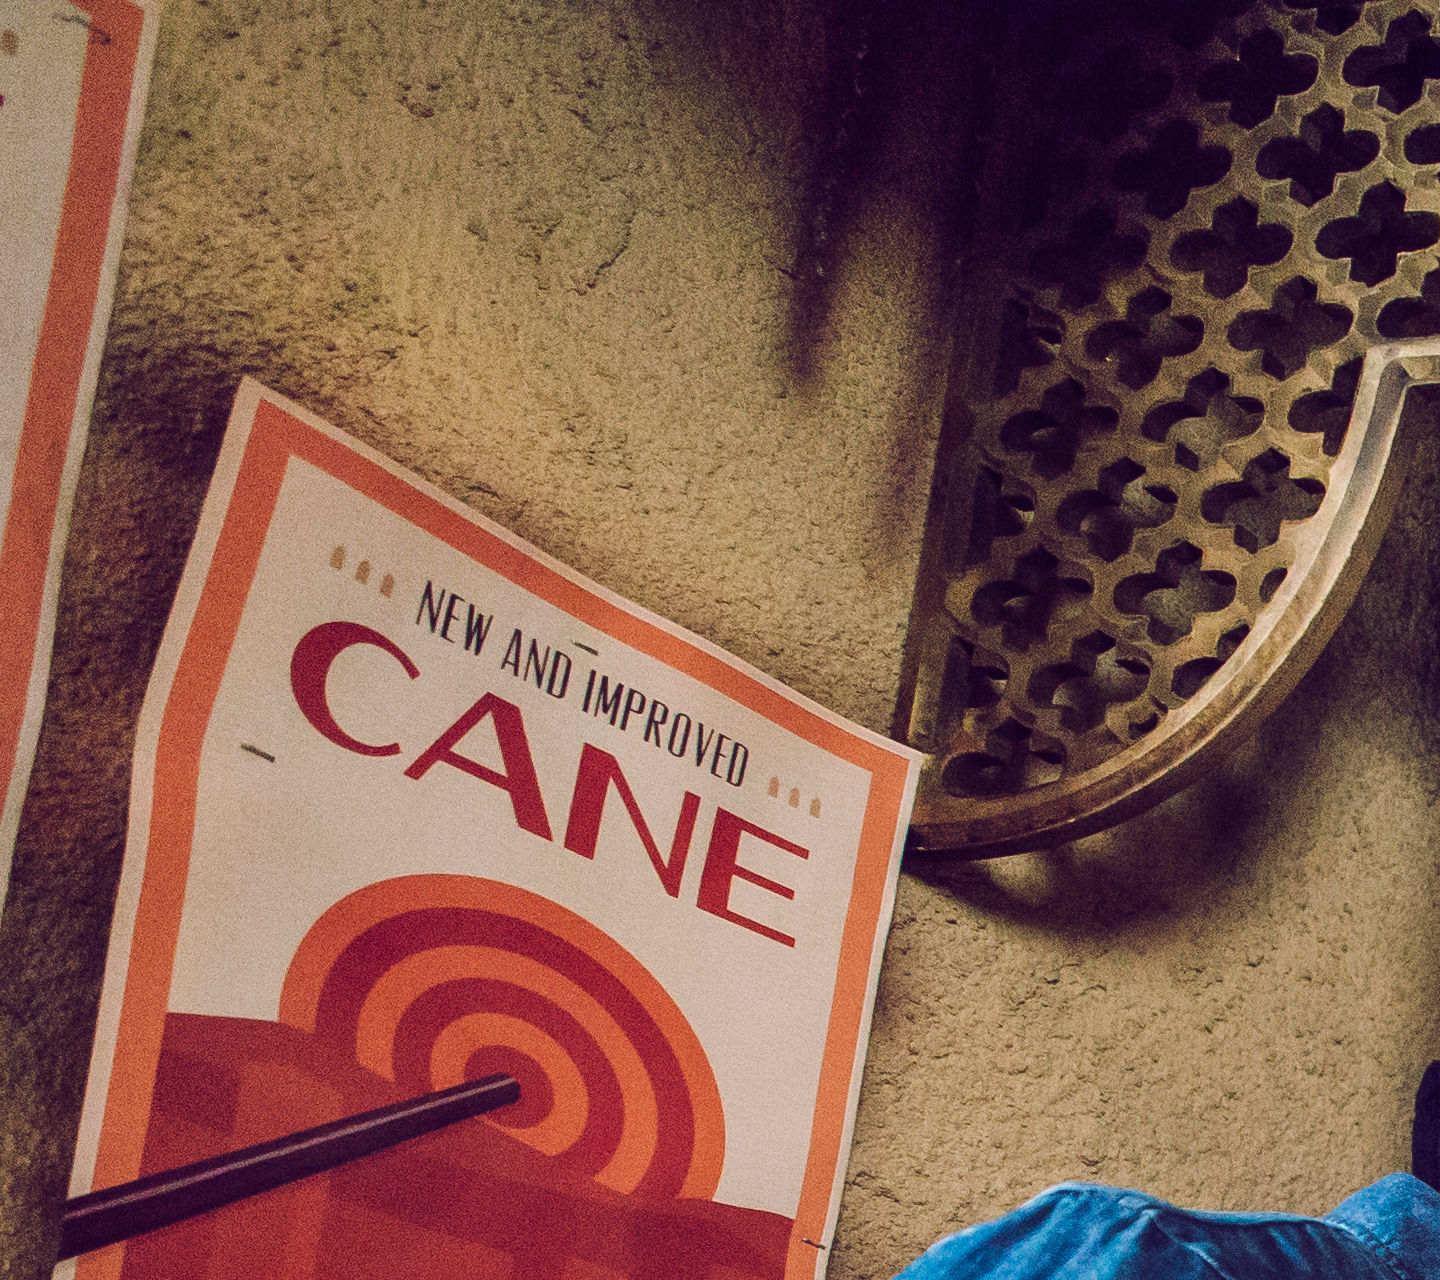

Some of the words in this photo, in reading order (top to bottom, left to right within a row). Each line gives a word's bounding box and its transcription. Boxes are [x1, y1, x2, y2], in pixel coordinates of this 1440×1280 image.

[290, 620, 811, 948] CANE
[416, 580, 494, 656] NEW
[501, 628, 572, 699] AND
[582, 669, 749, 788] IMPROVED
